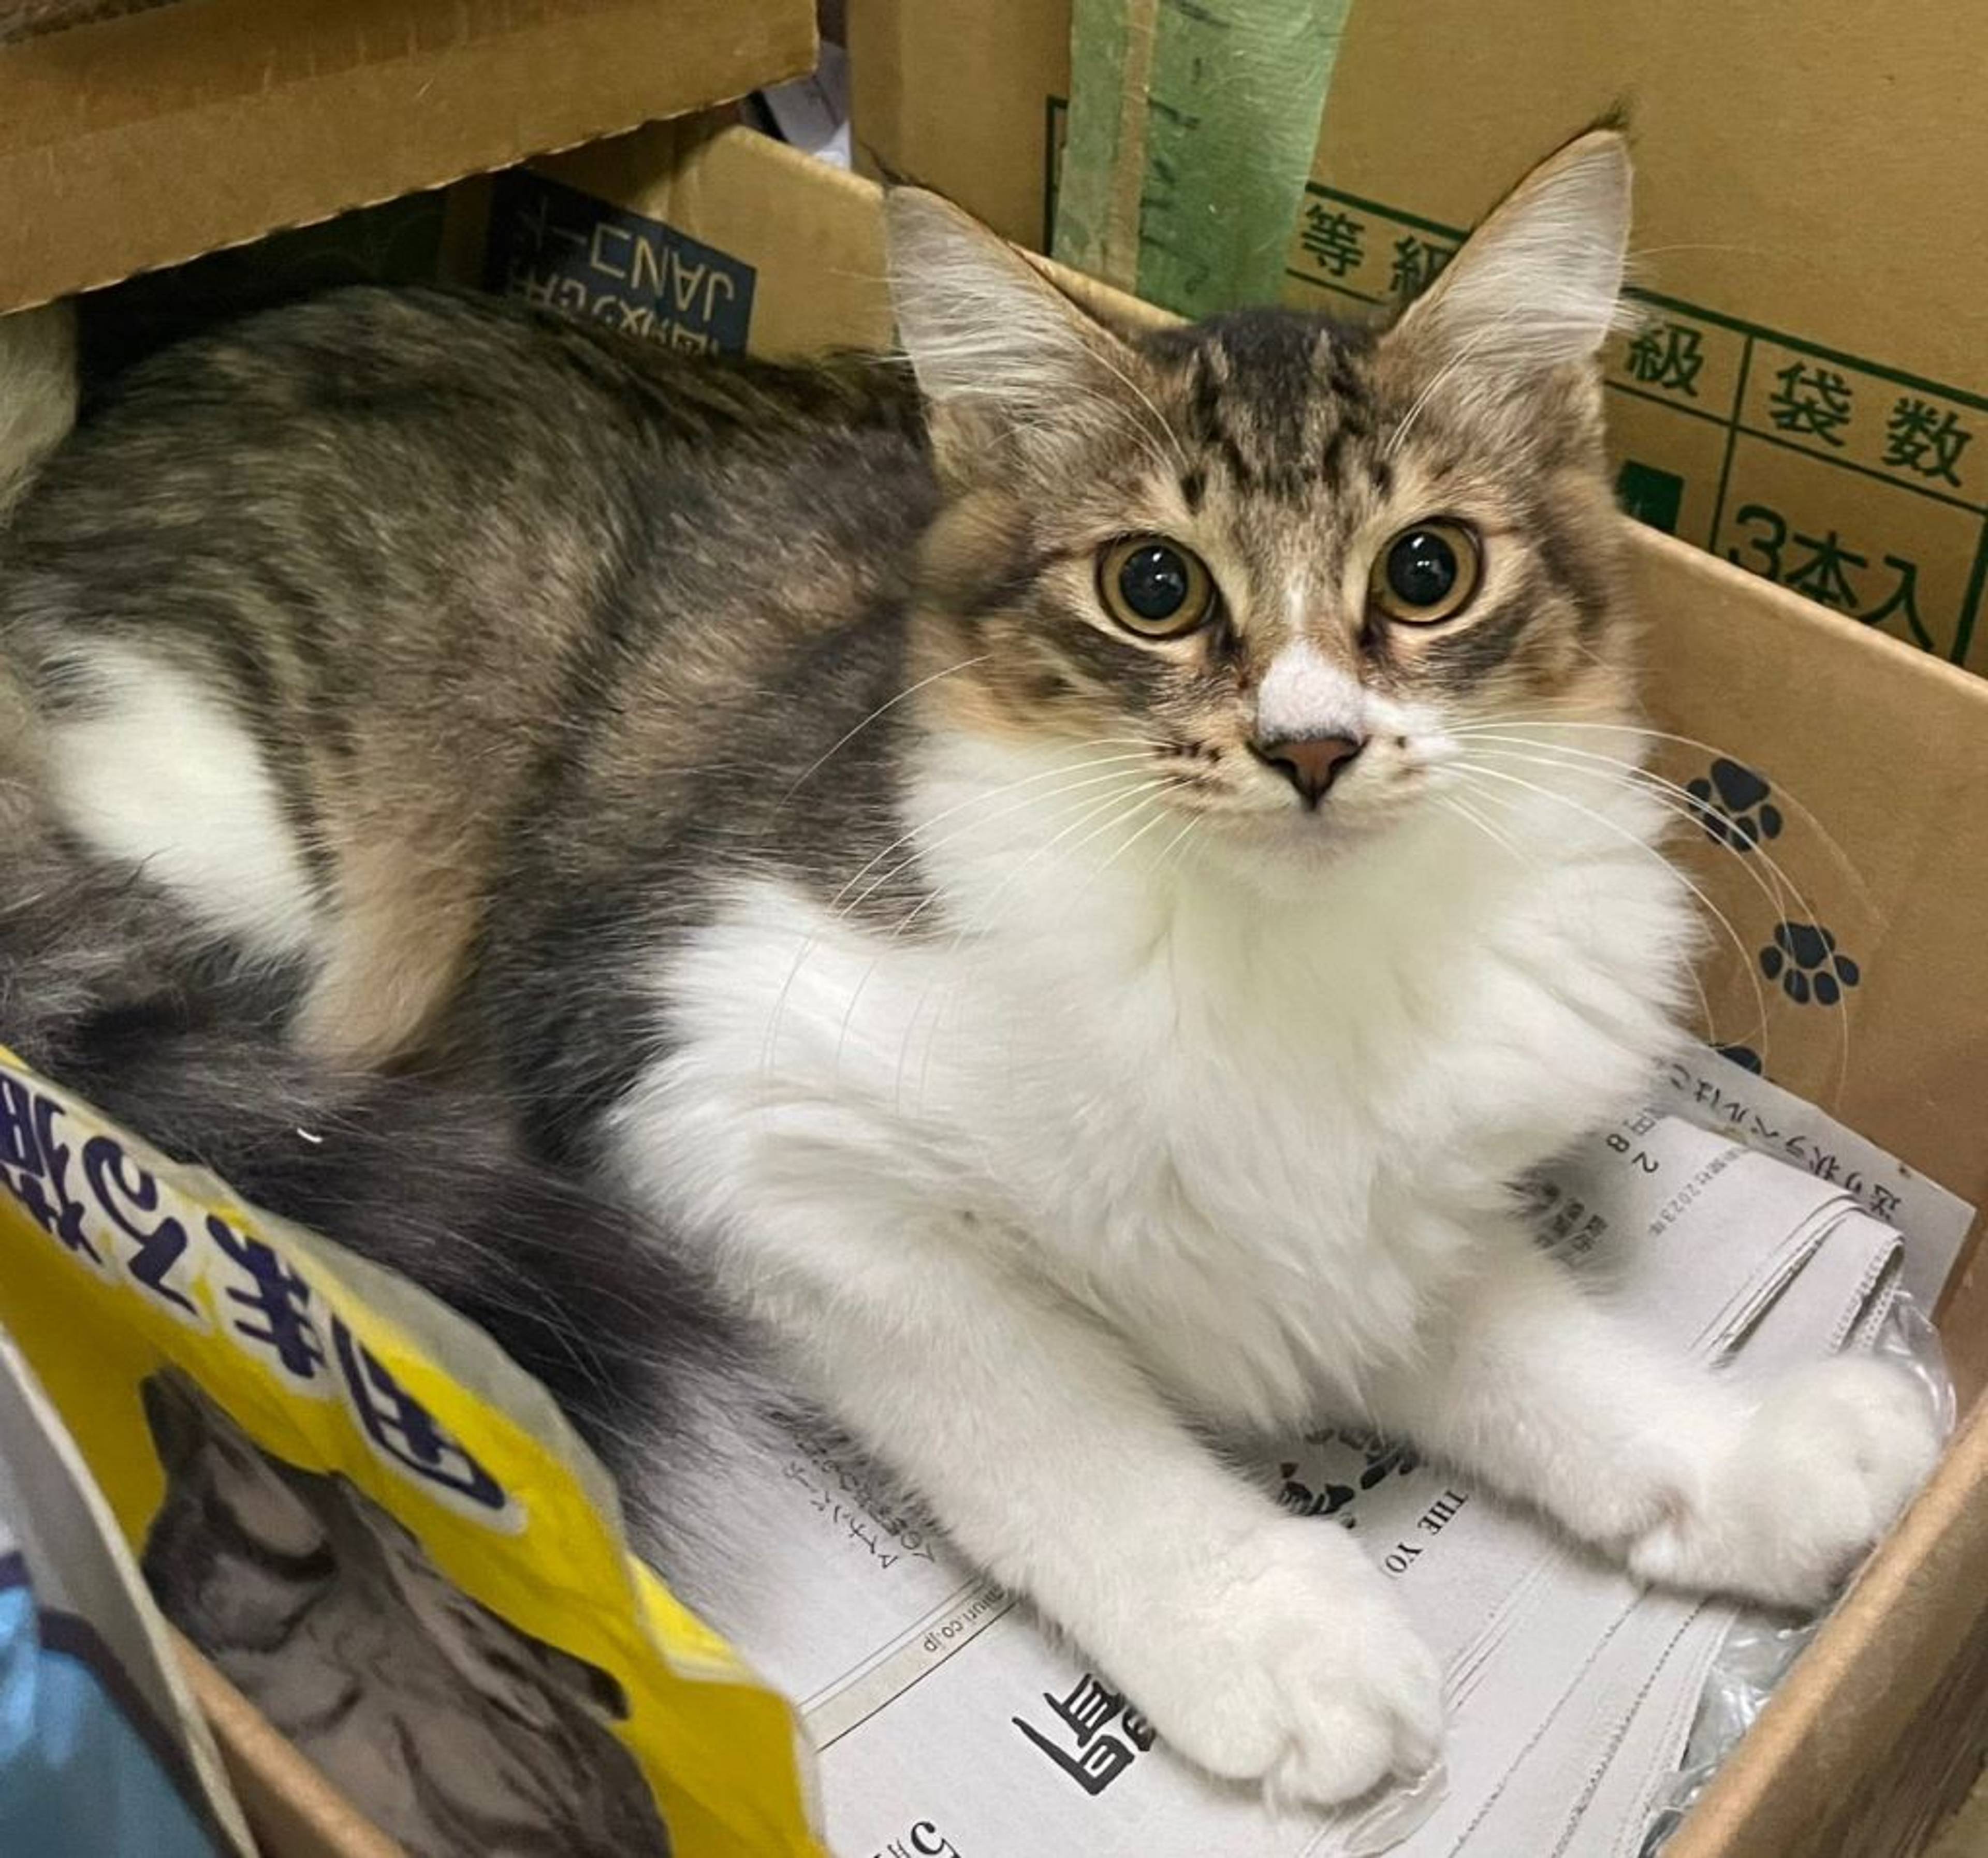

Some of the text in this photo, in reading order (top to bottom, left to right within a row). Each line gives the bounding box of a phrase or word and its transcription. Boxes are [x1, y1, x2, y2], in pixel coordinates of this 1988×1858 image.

[1768, 361, 1974, 488] 袋数
[1727, 504, 1936, 650] 3本入
[1380, 1490, 1468, 1579] THE YO
